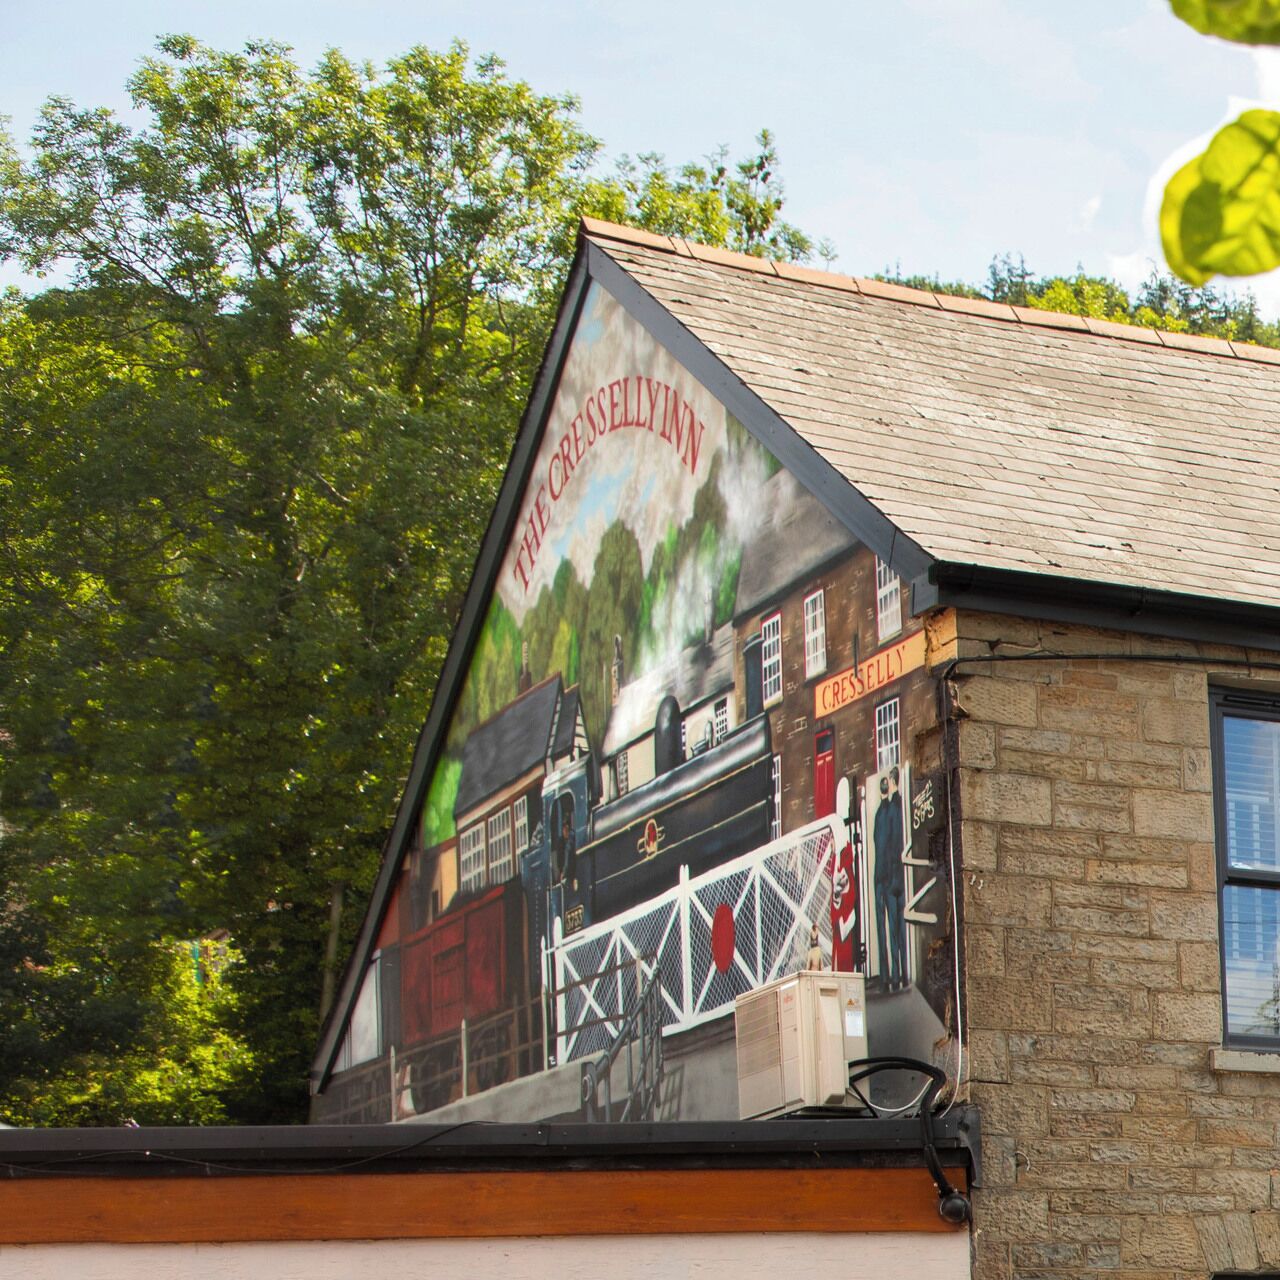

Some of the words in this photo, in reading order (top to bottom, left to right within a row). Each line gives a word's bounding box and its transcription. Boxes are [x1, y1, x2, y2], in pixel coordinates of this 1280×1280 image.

[513, 483, 551, 595] THE
[548, 374, 662, 502] CRESSELLY
[659, 379, 705, 476] INN
[821, 644, 906, 711] CRESSELLY
